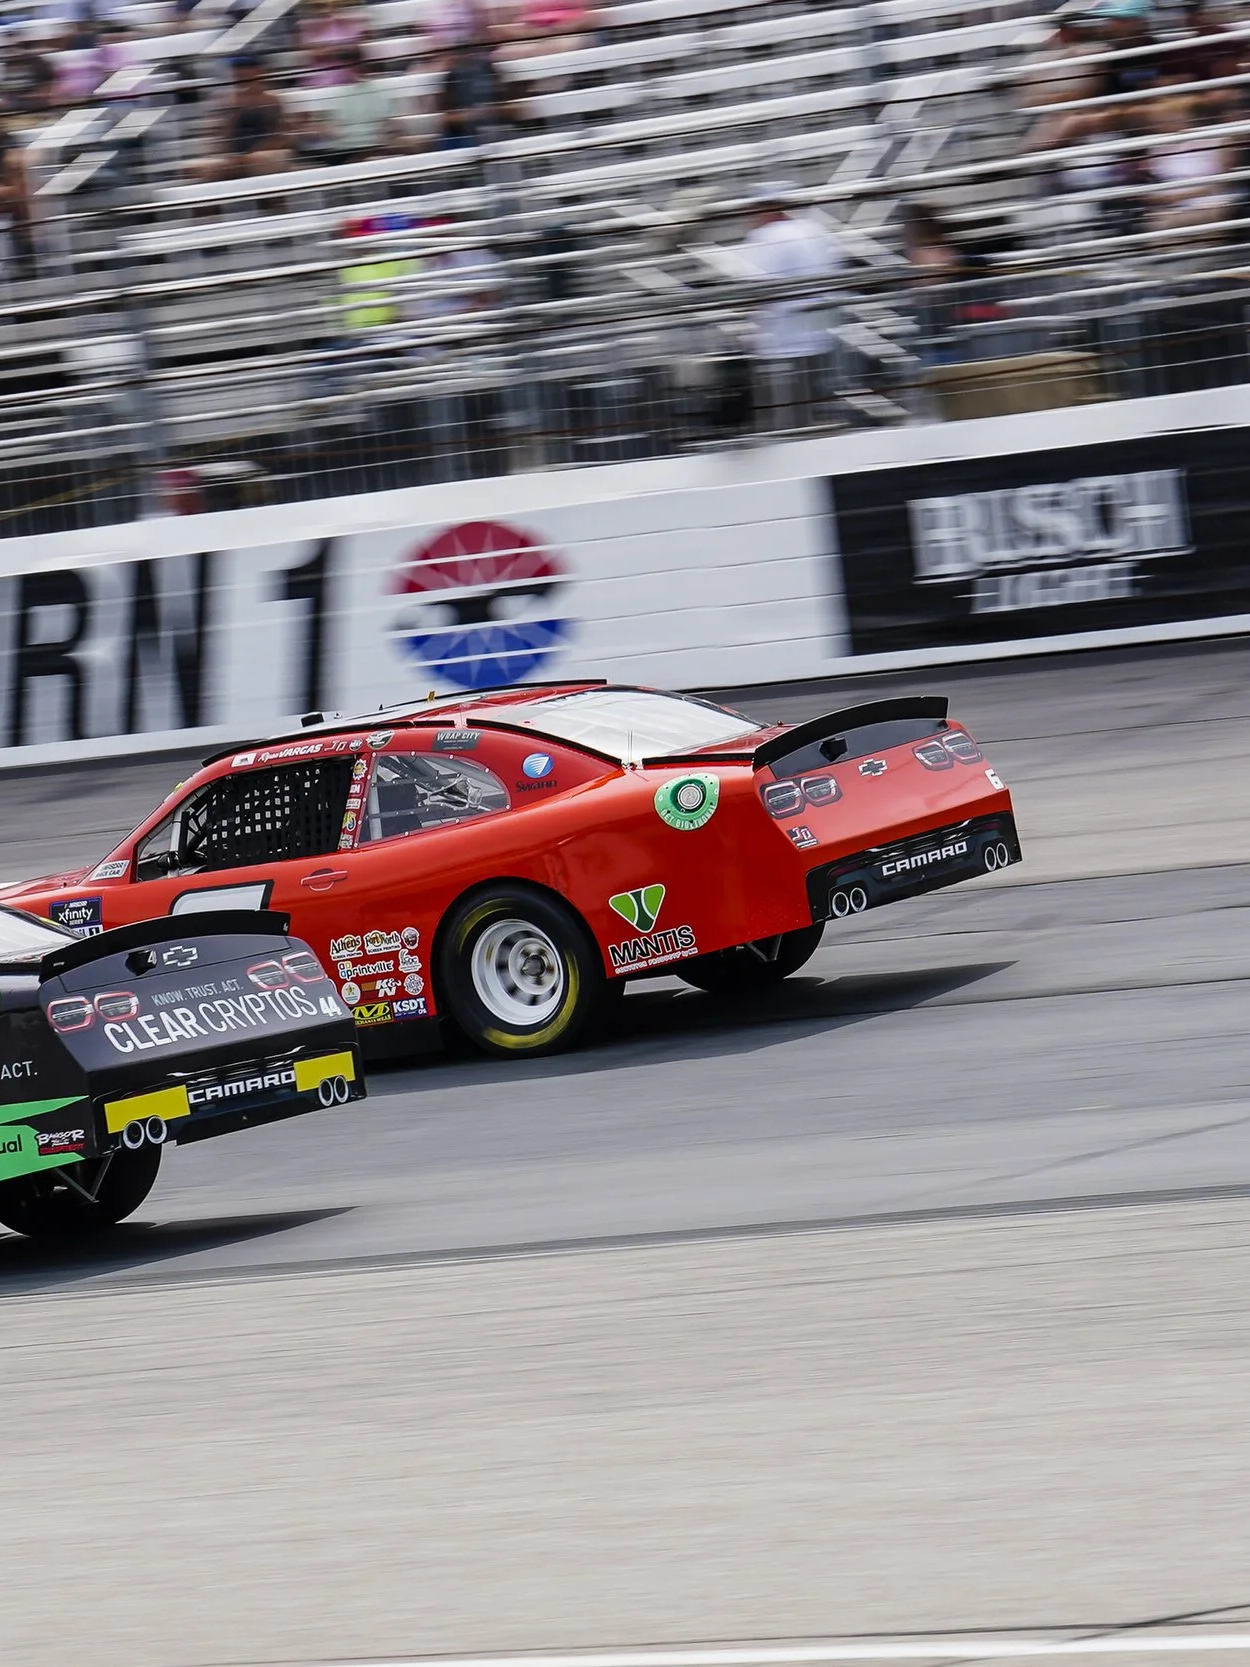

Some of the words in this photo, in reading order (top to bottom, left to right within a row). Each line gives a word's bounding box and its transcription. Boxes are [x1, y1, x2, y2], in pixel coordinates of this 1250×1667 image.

[260, 538, 334, 716] 1
[436, 731, 458, 741] WRAP
[462, 732, 481, 740] CITY
[278, 744, 323, 758] VARGAS
[515, 779, 558, 792] Swann
[660, 808, 675, 823] GET
[881, 841, 968, 876] CAMARO
[58, 907, 93, 924] xfinity
[331, 936, 361, 955] Athens
[608, 925, 696, 967] MANTIS
[346, 962, 394, 979] printville
[151, 989, 187, 1007] KNOW.
[184, 982, 223, 1000] TRUST.
[221, 978, 245, 993] ACT.
[392, 997, 426, 1013] KSDT
[103, 1007, 209, 1053] CLEAR
[198, 986, 318, 1032] CRYPTOS
[318, 996, 343, 1017] 44
[0, 1060, 39, 1080] ACT.
[188, 1070, 297, 1104] CAMARO
